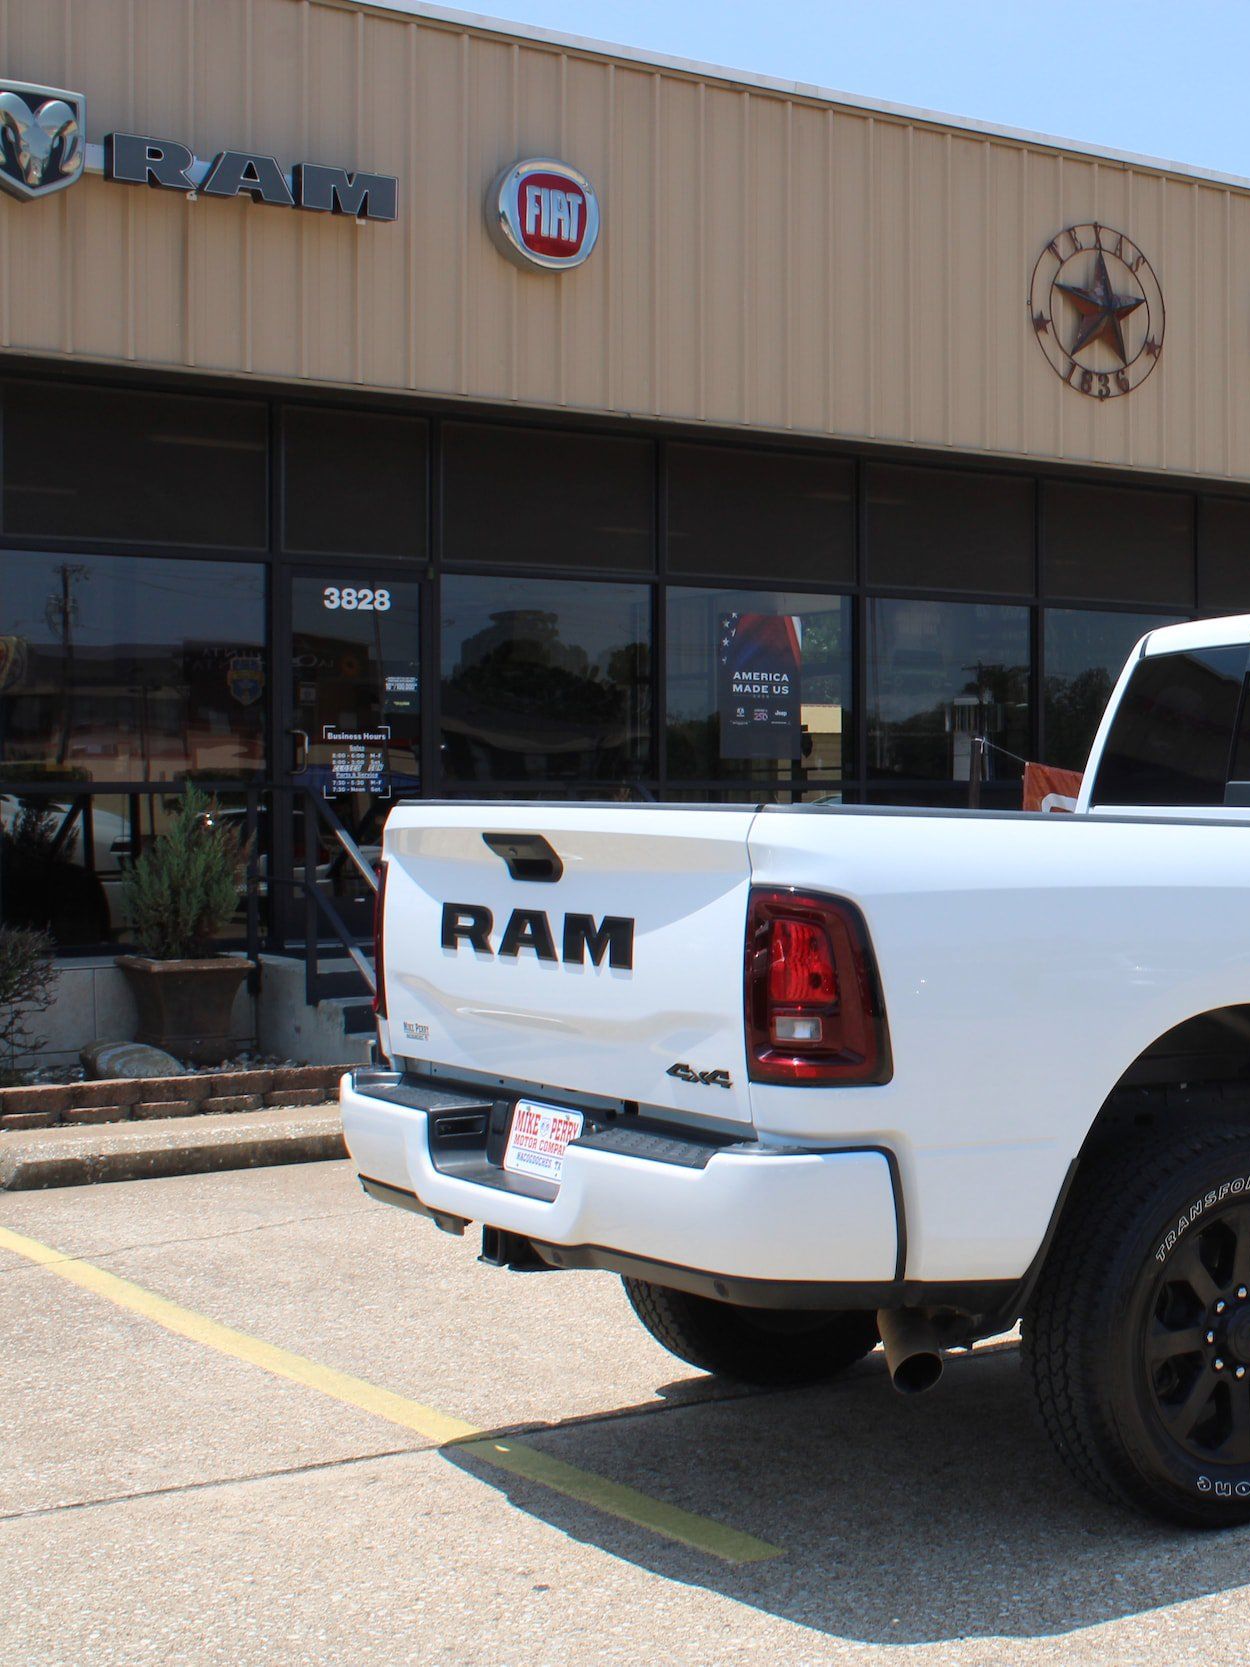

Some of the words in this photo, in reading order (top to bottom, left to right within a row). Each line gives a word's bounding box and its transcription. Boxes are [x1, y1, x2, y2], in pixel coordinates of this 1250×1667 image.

[104, 131, 398, 222] RAM
[526, 185, 583, 243] FIAT
[1047, 222, 1147, 273] TEXAS
[1063, 361, 1130, 399] 1836
[323, 587, 391, 611] 3828
[732, 684, 769, 693] MADE
[772, 685, 790, 695] US
[733, 671, 790, 682] AMERICA
[327, 732, 362, 740] Business
[363, 732, 387, 740] Hours
[441, 902, 635, 970] RAM
[514, 1134, 538, 1151] MOTOR
[515, 1110, 541, 1135] MIKE
[549, 1118, 579, 1144] PERRY
